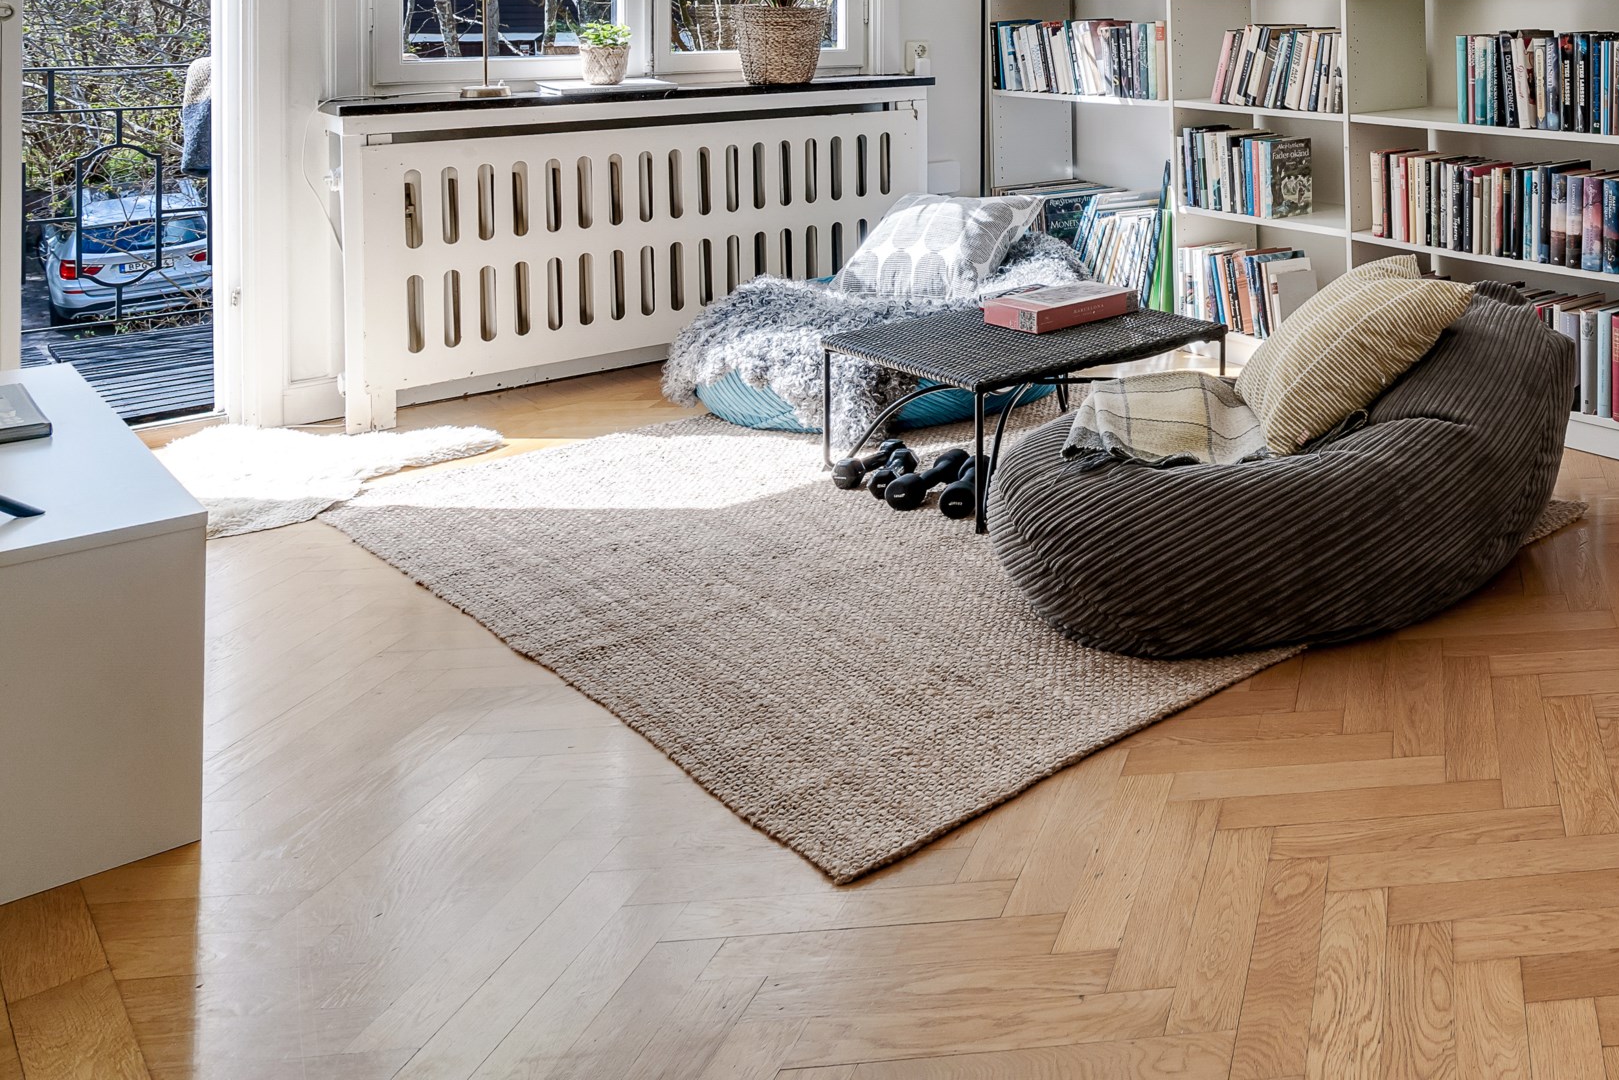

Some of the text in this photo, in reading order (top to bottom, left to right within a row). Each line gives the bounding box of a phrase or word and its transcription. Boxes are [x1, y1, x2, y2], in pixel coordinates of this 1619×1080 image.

[1293, 40, 1304, 67] ROOTS
[1504, 54, 1512, 71] DAVID
[1272, 148, 1310, 160] Fader okänd
